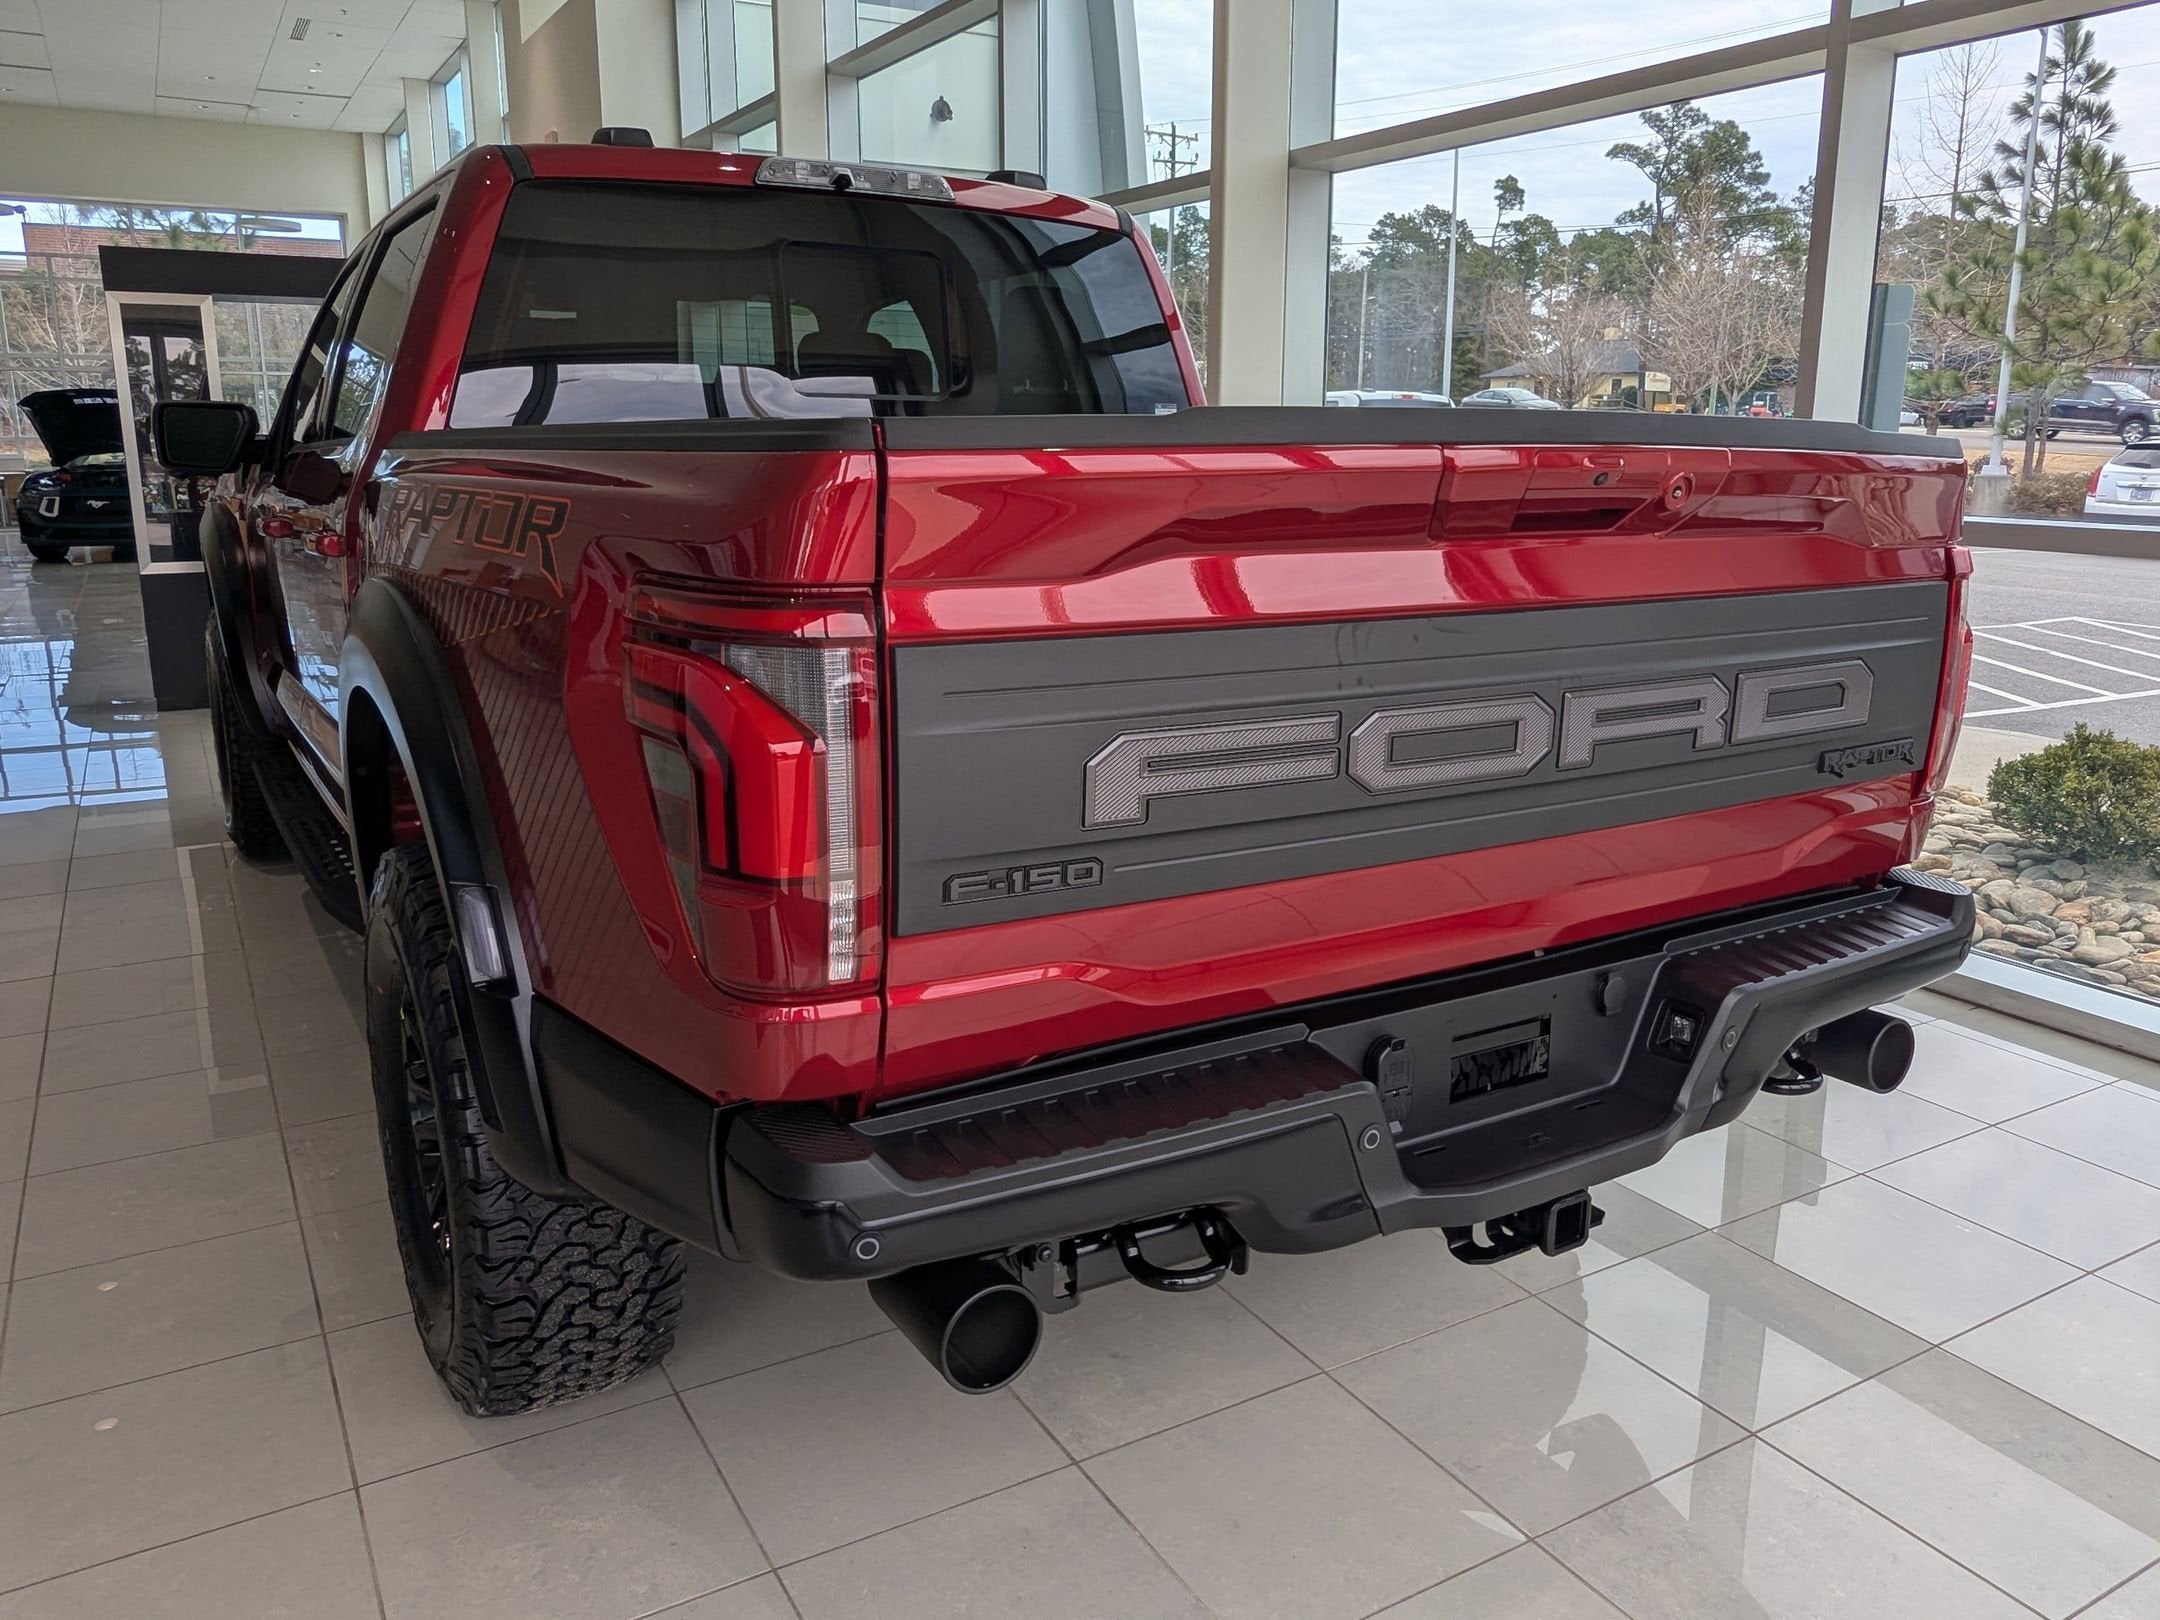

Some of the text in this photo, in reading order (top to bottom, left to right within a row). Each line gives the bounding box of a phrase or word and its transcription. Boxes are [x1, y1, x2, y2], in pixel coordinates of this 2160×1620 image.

[384, 481, 571, 598] RAPTOR
[1082, 657, 1874, 831] FORD
[1816, 737, 1915, 779] RAPTOR
[942, 857, 1104, 907] F-150
